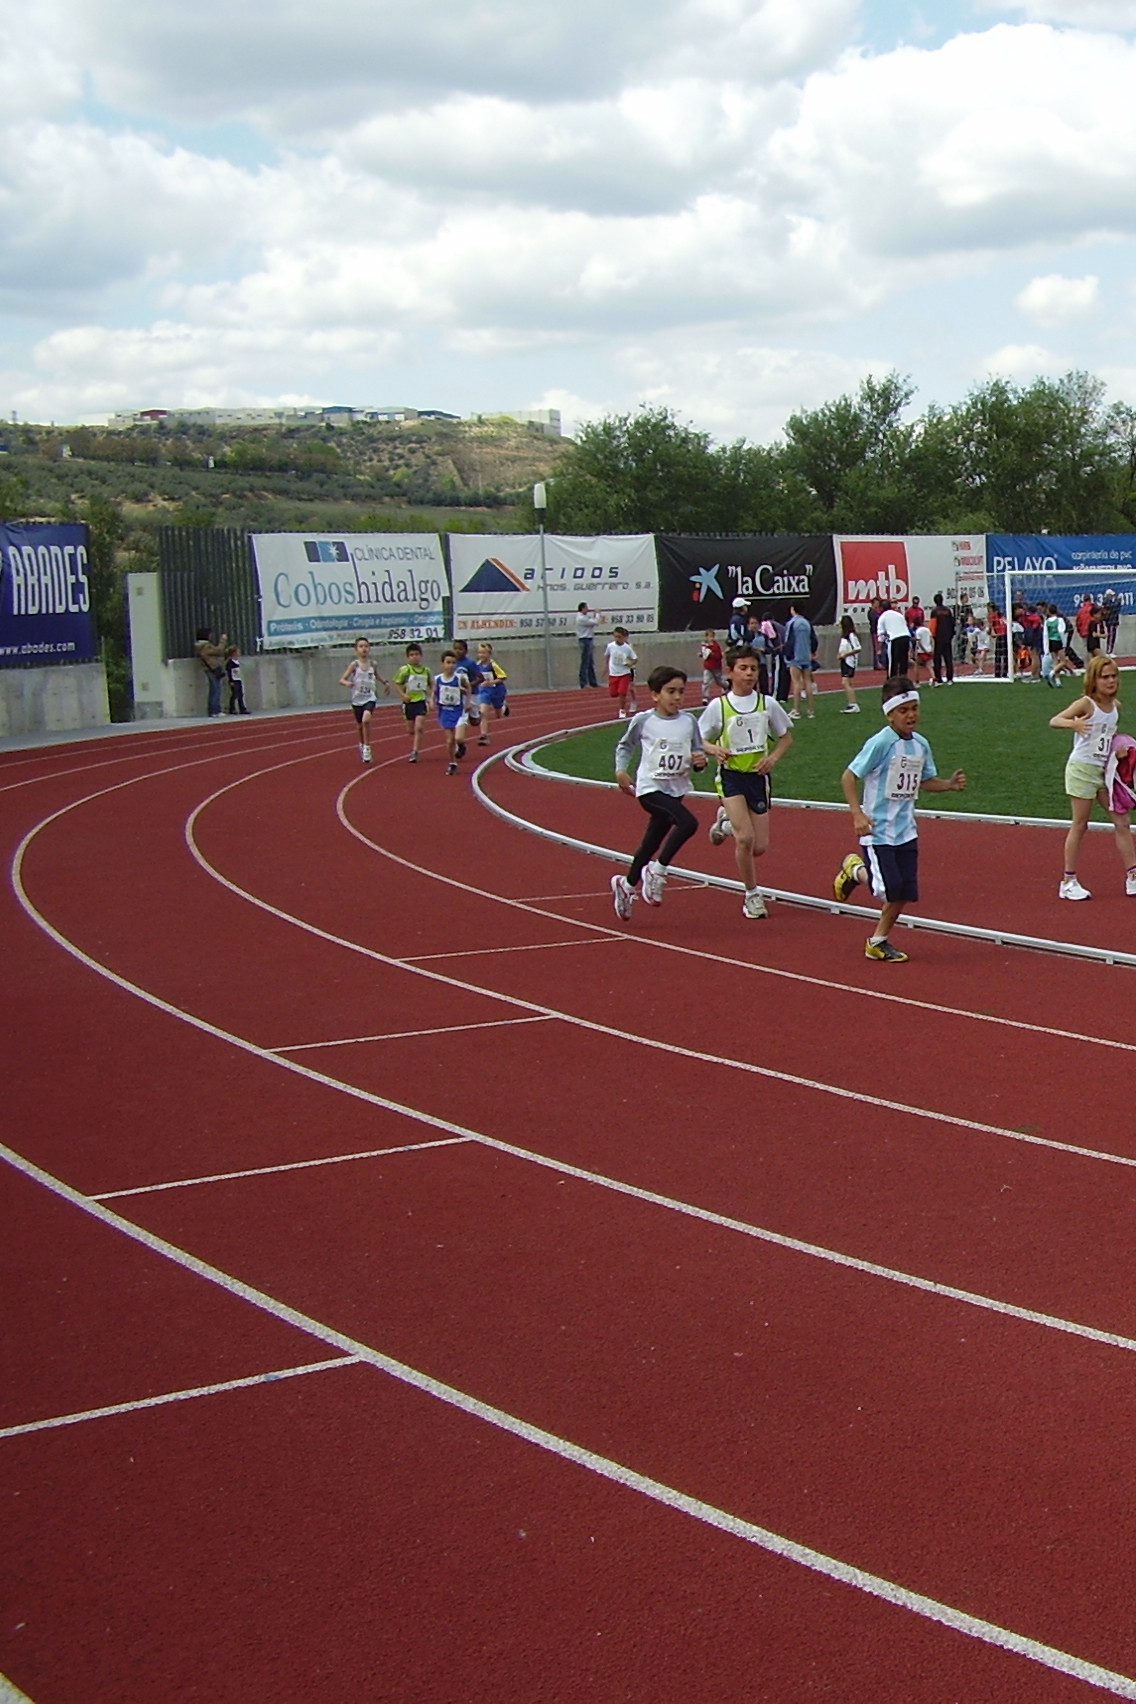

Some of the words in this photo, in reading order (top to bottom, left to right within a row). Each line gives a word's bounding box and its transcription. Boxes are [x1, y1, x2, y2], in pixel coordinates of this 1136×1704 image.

[397, 546, 436, 561] DENTAL
[8, 545, 90, 615] ABADES
[848, 564, 907, 600] mtb
[409, 628, 423, 638] 32
[747, 728, 754, 744] 1
[659, 754, 683, 771] 407
[897, 773, 918, 791] 315
